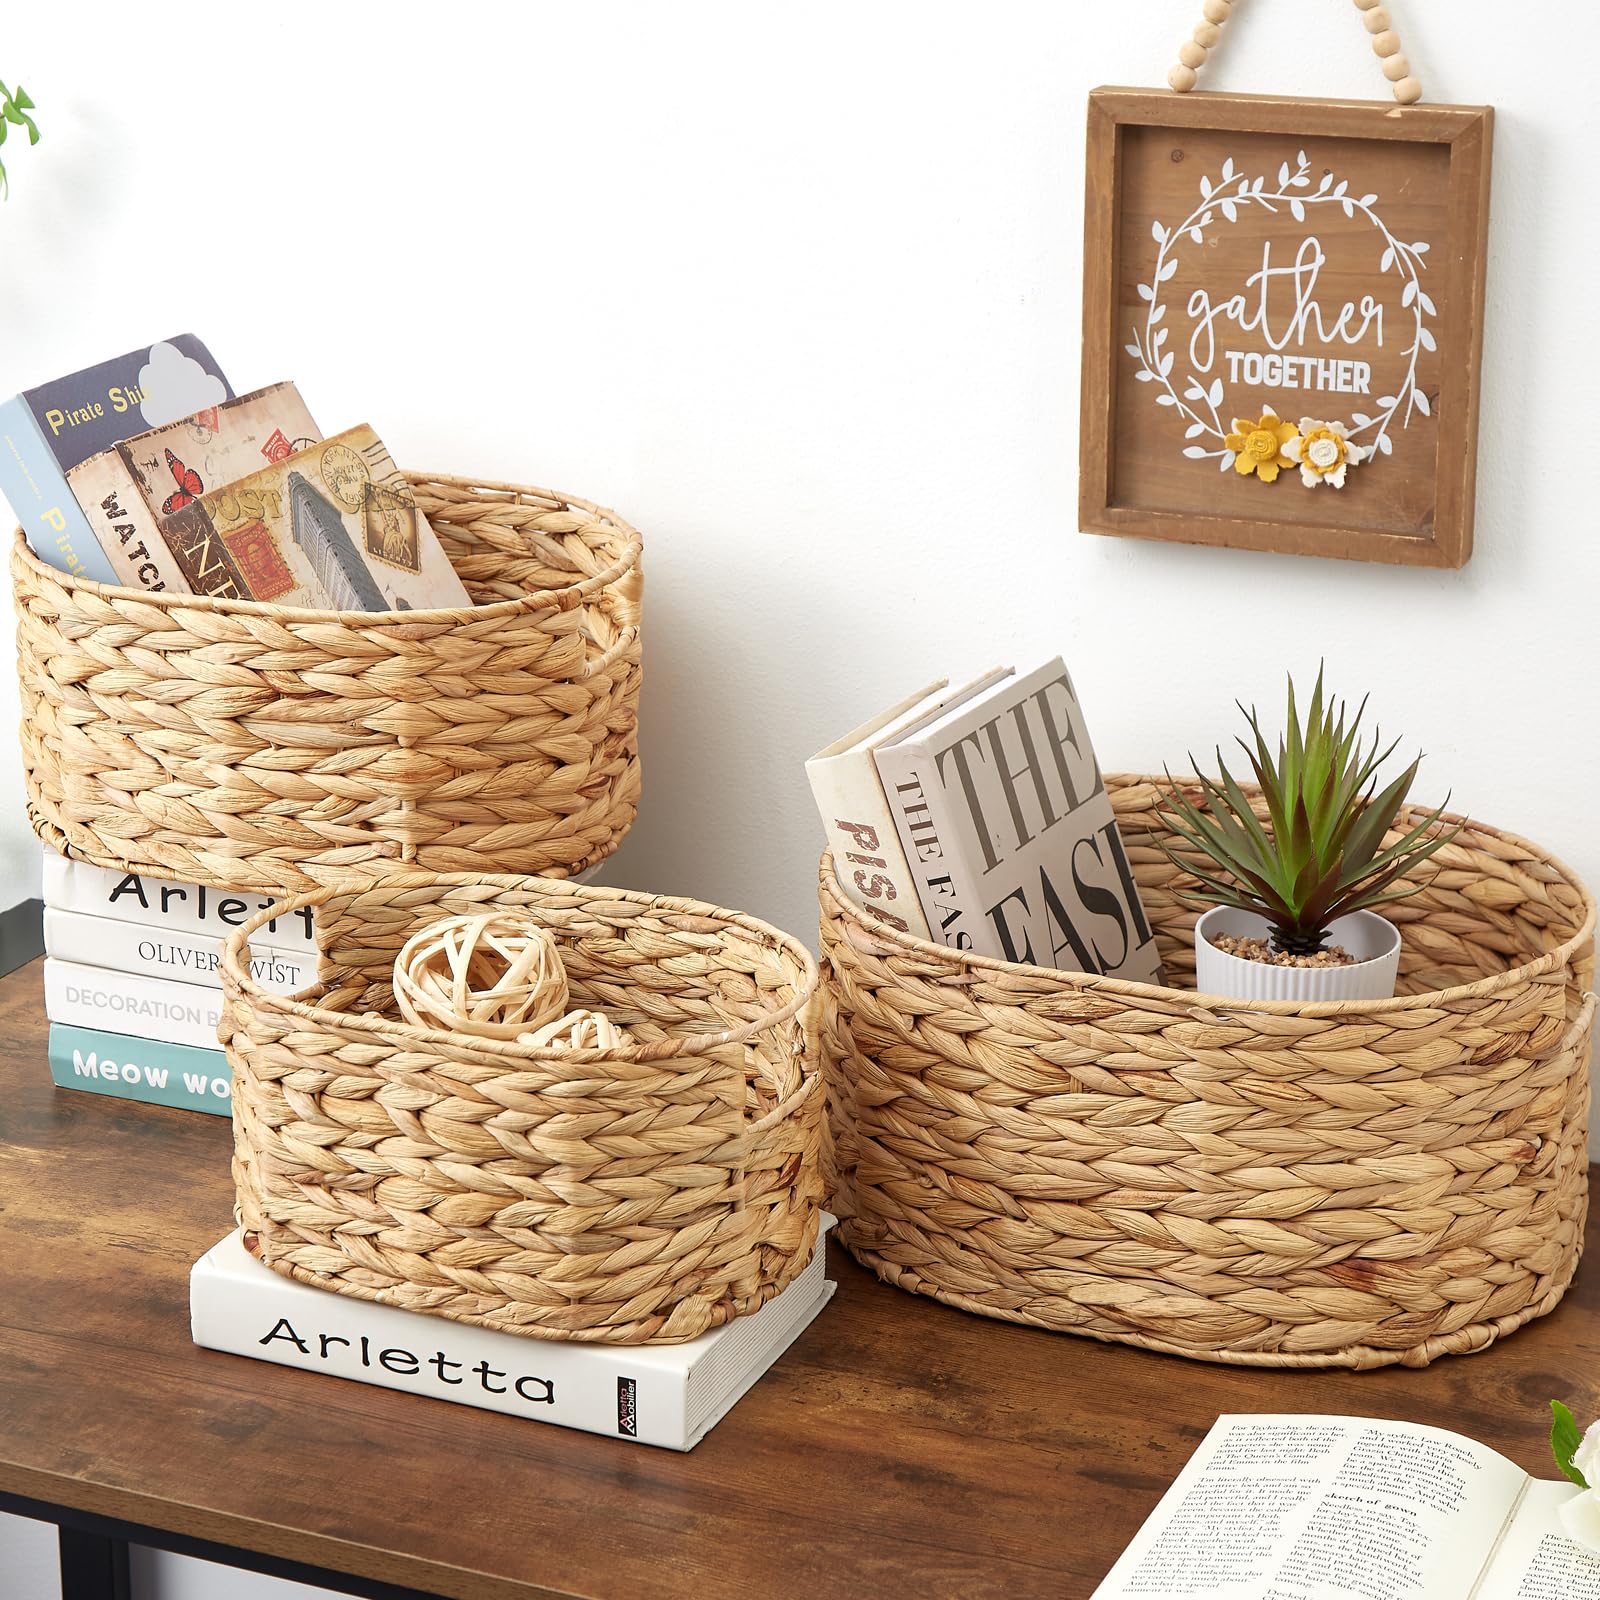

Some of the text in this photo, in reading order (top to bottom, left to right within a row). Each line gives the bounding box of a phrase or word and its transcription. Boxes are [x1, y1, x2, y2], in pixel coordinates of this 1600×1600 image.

[1187, 236, 1384, 373] gather
[1225, 351, 1371, 394] TOGETHER
[45, 402, 104, 436] Pirate
[934, 674, 1104, 875] THE
[894, 771, 944, 864] THE
[138, 941, 300, 986] OLIVER WIST
[66, 986, 201, 1024] DECORATION
[72, 1049, 231, 1098] Meow wo
[259, 1318, 555, 1404] Arletta
[626, 1381, 635, 1434] Mobilier
